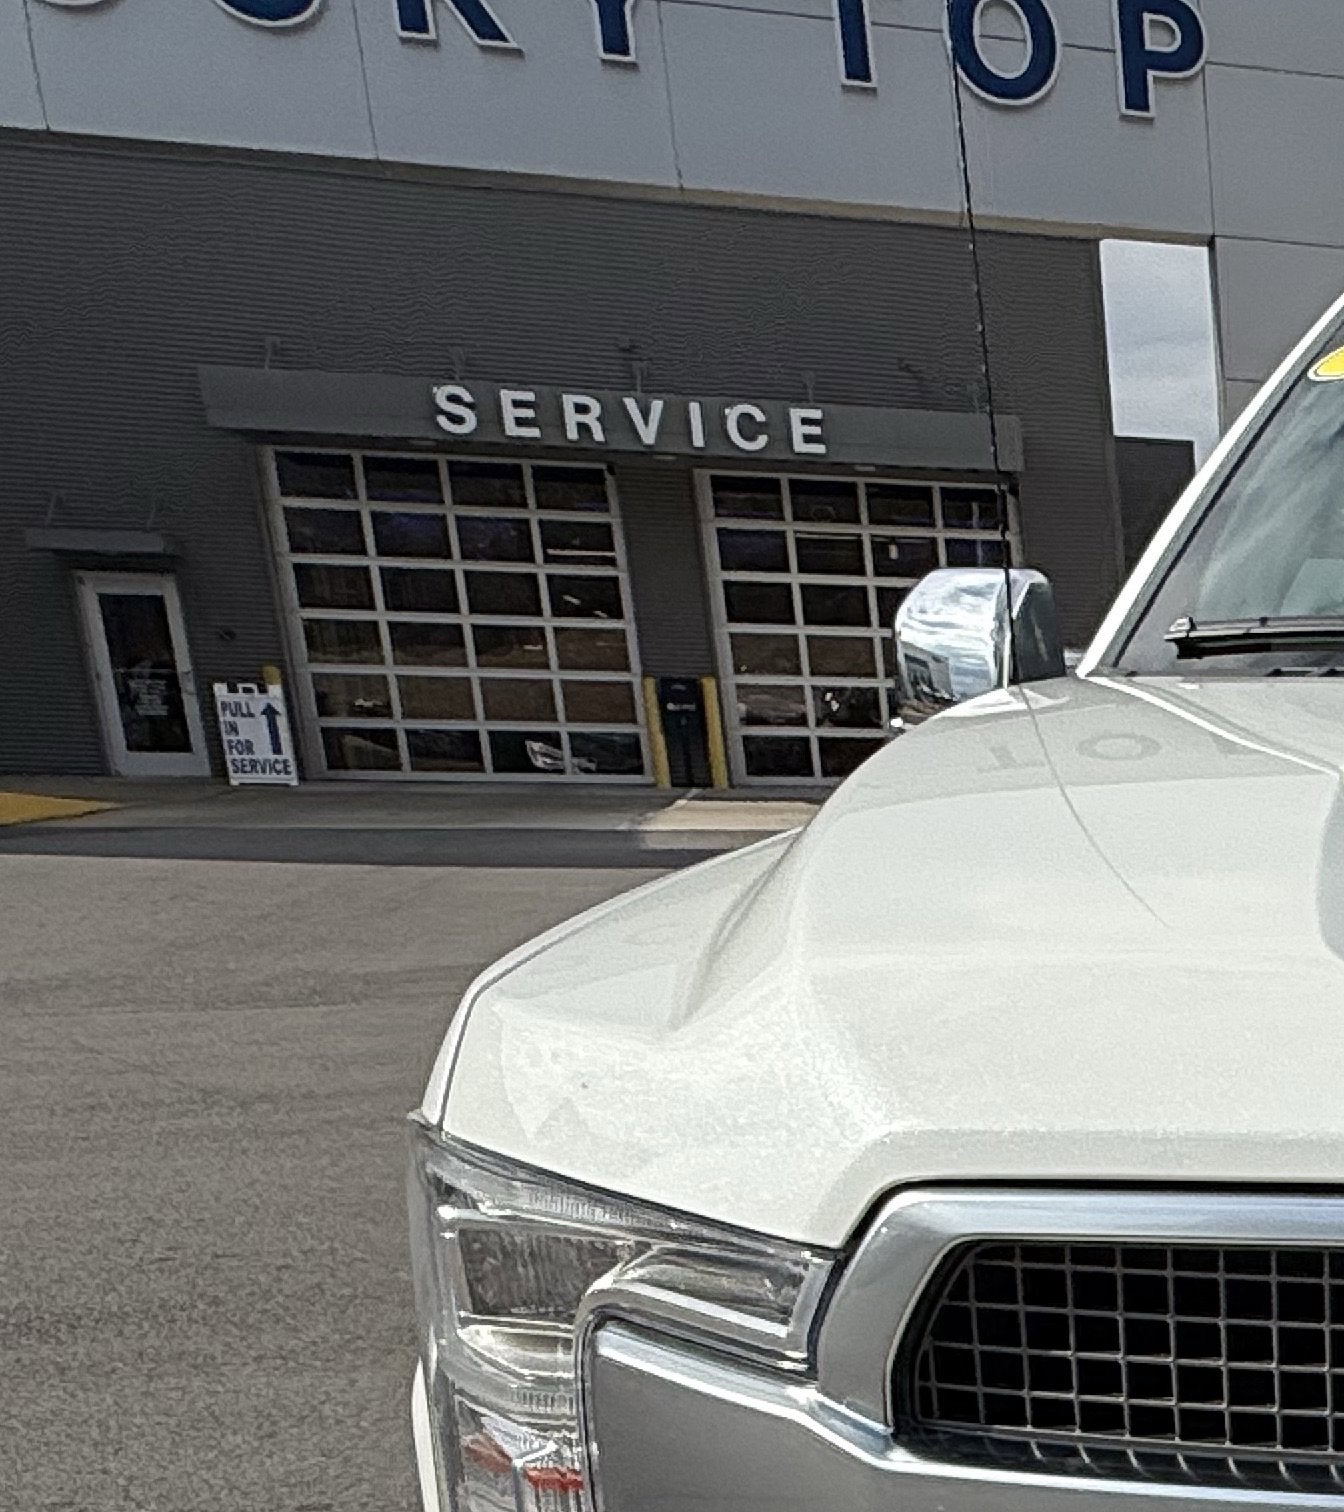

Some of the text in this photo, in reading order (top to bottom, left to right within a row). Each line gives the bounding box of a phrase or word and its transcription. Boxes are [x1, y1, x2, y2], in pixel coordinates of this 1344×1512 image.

[434, 384, 827, 454] SERVICE
[221, 700, 255, 718] PULL
[224, 720, 240, 736] IN
[226, 739, 255, 755] FOR
[230, 758, 292, 776] SERVICE
